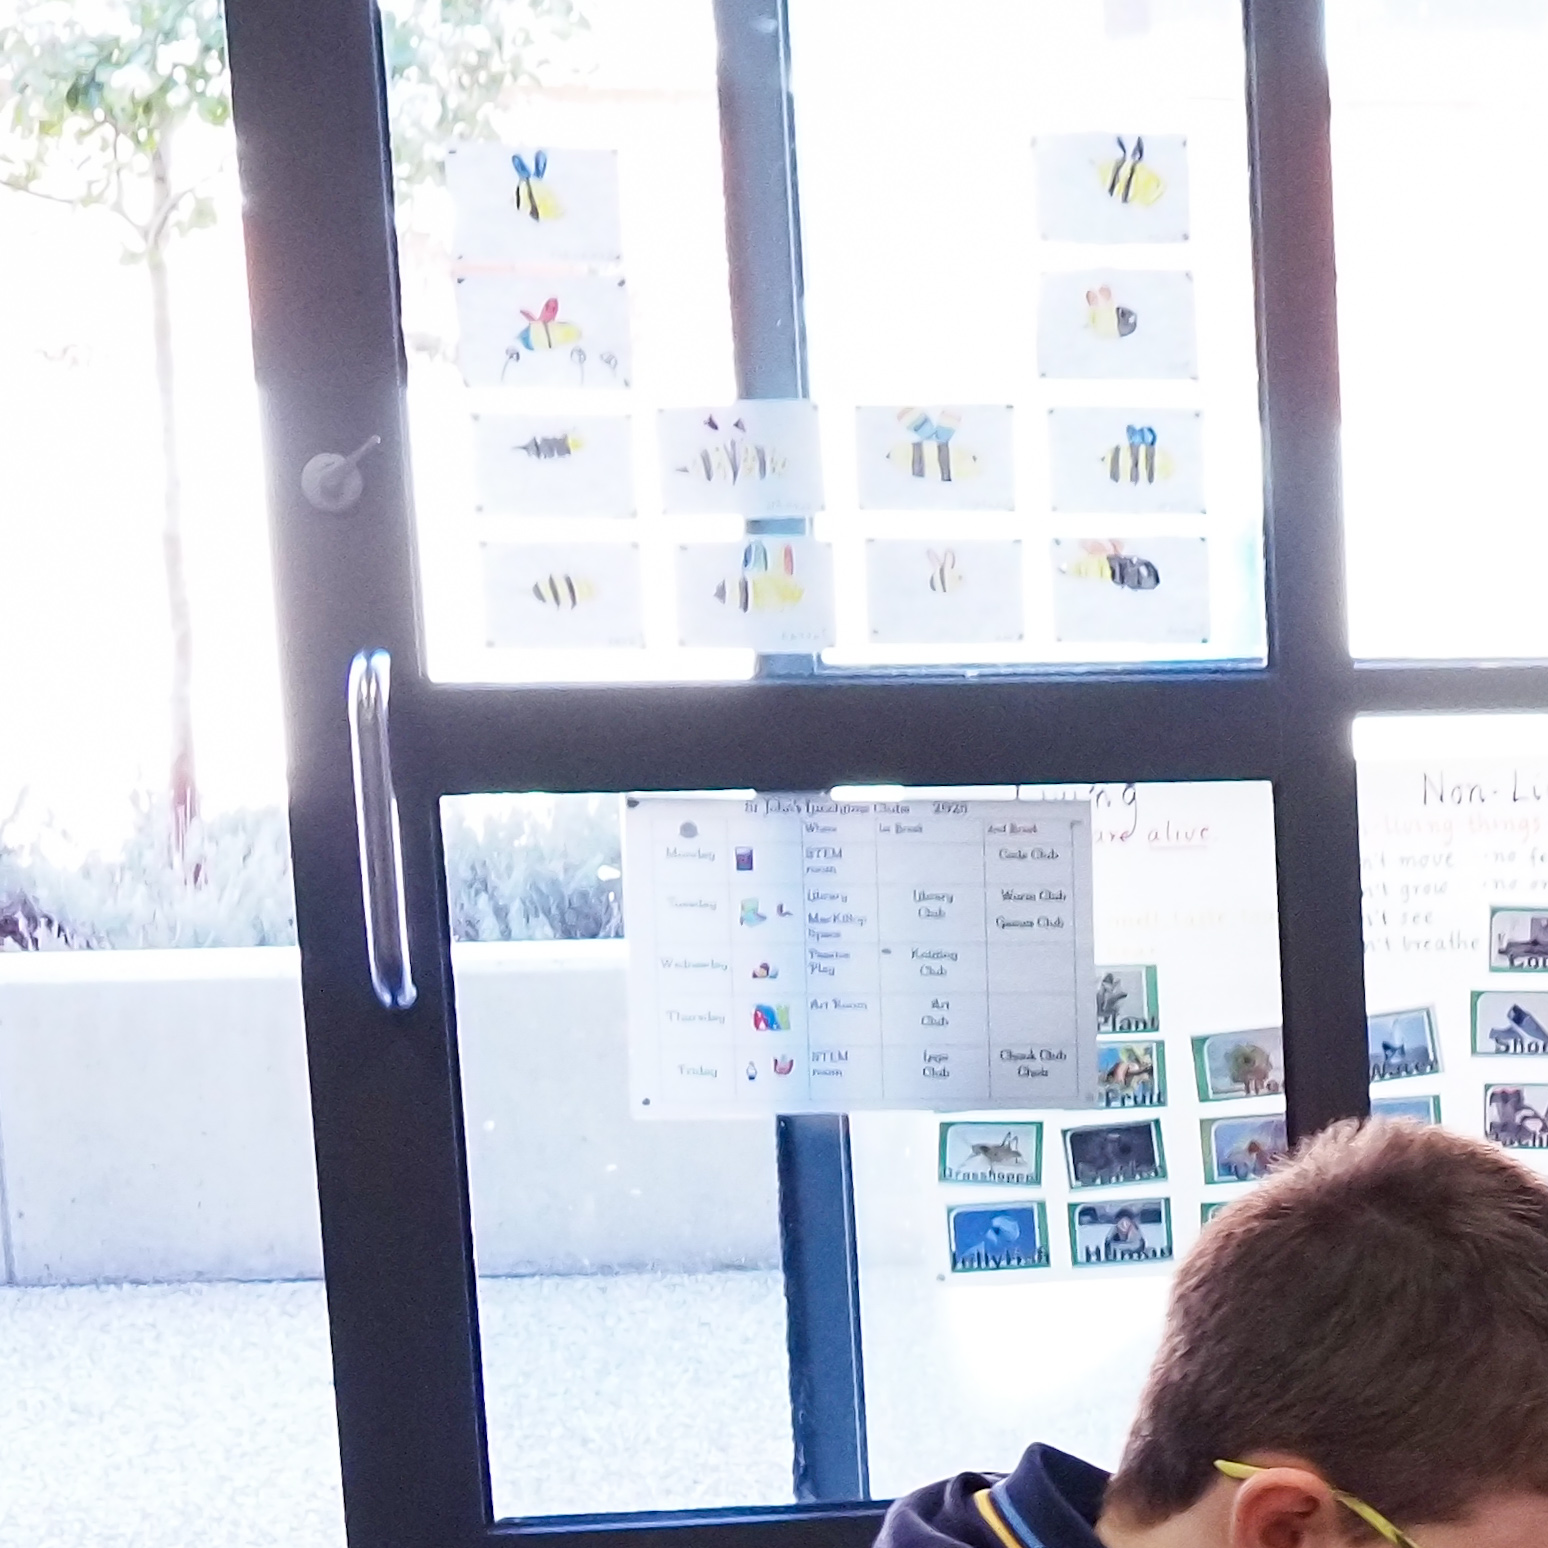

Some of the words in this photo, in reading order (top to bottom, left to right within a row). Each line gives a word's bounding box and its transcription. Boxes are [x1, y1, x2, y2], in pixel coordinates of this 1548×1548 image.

[1399, 852, 1454, 869] move
[1400, 881, 1449, 902] grow
[1403, 930, 1481, 952] breathe
